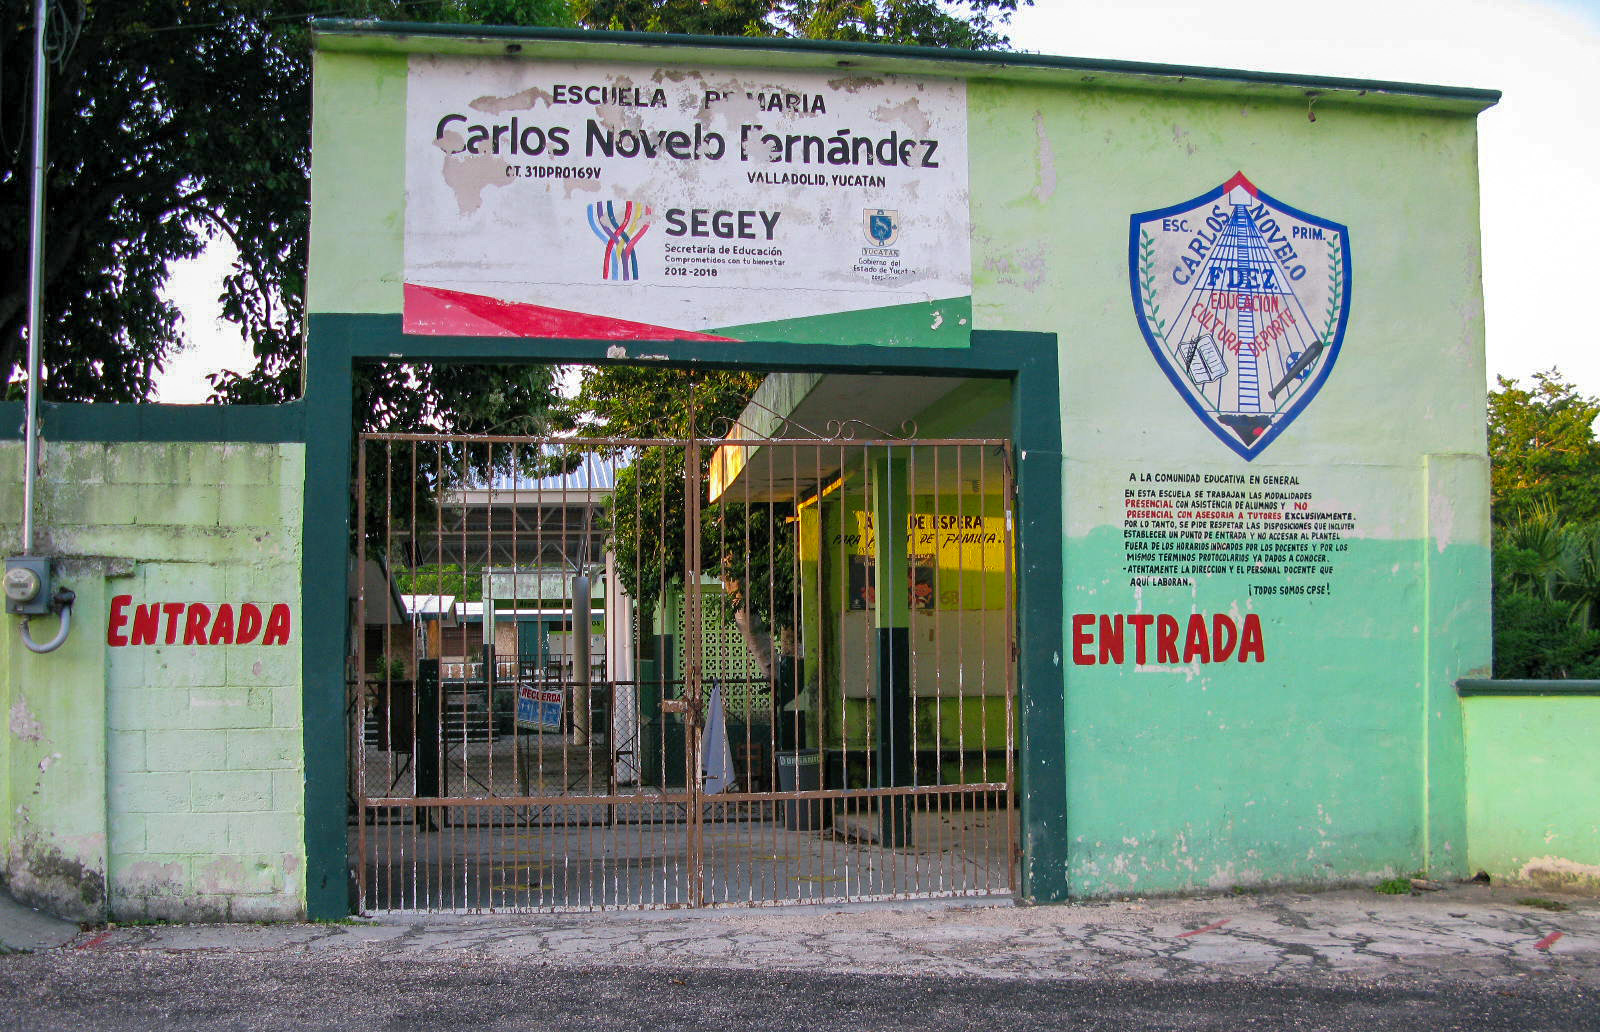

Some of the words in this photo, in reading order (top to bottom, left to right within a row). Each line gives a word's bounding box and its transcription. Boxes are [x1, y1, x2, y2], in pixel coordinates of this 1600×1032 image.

[553, 84, 668, 108] ESCUELA
[704, 90, 827, 114] PMARIA
[436, 113, 570, 157] Carlos
[585, 119, 726, 160] Novelo
[740, 124, 939, 168] Fernández
[747, 171, 829, 187] VALLADOLID,
[832, 174, 886, 188] YUCATAN
[665, 208, 781, 240] SEGEY
[1162, 218, 1193, 233] ESC.
[1292, 226, 1327, 241] PRIM.
[1172, 204, 1230, 286] CARLOS
[1250, 203, 1307, 281] NOVELO
[719, 245, 730, 254] de
[733, 246, 782, 256] Educación
[664, 255, 725, 264] Comprometidos
[858, 258, 886, 266] Gobierno
[853, 264, 878, 272] Estado
[889, 267, 916, 275] Yucatn
[1211, 293, 1279, 313] EDUCACION
[1191, 303, 1243, 356] CULTURA
[1248, 308, 1297, 358] DEPORTE
[1129, 472, 1136, 482] A
[1140, 473, 1152, 482] LA
[1154, 474, 1200, 483] COMUNIDAD
[1204, 474, 1246, 484] EDUCATIVA
[1249, 475, 1260, 484] EN
[1262, 476, 1300, 486] GENERAL
[1124, 490, 1134, 498] EN
[1138, 490, 1156, 498] ESTA
[1160, 490, 1192, 498] ESCUELA
[1194, 490, 1204, 498] SE
[1206, 490, 1246, 499] TRABAJAN
[1249, 492, 1262, 500] LAS
[1264, 492, 1312, 500] MODALIDADES
[1125, 499, 1174, 508] PRESENCIAL
[1175, 500, 1188, 509] CON
[1191, 500, 1232, 509] ASISTENCIA
[1235, 501, 1244, 509] DE
[1245, 502, 1278, 510] ALUMNOS
[1280, 502, 1286, 510] Y
[1294, 502, 1308, 510] NO
[1126, 510, 1174, 519] PRESENCIAL
[1177, 510, 1192, 519] CON
[1196, 511, 1234, 520] ASESORIA
[1248, 512, 1282, 520] TUTORES
[1284, 512, 1356, 520] EXCLUSIVAMENTE.
[933, 515, 983, 530] ESPERA
[1124, 520, 1138, 528] POR
[1140, 520, 1150, 528] LO
[1152, 520, 1177, 529] TANTO,
[1191, 521, 1207, 529] PIDE
[1210, 521, 1244, 529] RESPETAR
[1264, 522, 1312, 530] DISPOSICIONES
[1314, 522, 1326, 530] QUE
[1124, 530, 1166, 538] ESTABLECER
[1168, 530, 1178, 539] UN
[1180, 530, 1202, 539] PUNTO
[1204, 531, 1212, 540] DE
[1215, 531, 1247, 540] ENTRADA
[1250, 532, 1256, 540] Y
[1257, 532, 1267, 540] NO
[1269, 532, 1298, 540] ACCESAR
[1125, 542, 1148, 550] FUERA
[1151, 542, 1160, 550] DE
[1162, 542, 1174, 550] LOS
[1176, 542, 1209, 550] HORARIOS
[1210, 542, 1243, 551] INDICADOS
[1245, 543, 1258, 551] POR
[1260, 543, 1273, 551] LOS
[1275, 543, 1308, 552] DOCENTES
[1312, 544, 1317, 552] Y
[1320, 544, 1333, 552] POR
[1336, 544, 1348, 552] LOS
[1126, 553, 1156, 561] MISMOS
[1158, 553, 1196, 562] TERMINOS
[1199, 553, 1249, 562] PROTOCOLARIOS
[1252, 554, 1262, 562] YA
[1264, 554, 1286, 562] DADOS
[1295, 554, 1330, 562] CONOCER.
[1181, 565, 1190, 574] LA
[1192, 566, 1227, 574] DIRECCION
[1228, 566, 1234, 574] Y
[1246, 566, 1281, 574] PERSONAL
[1284, 566, 1316, 574] DOCENTE
[1320, 566, 1334, 574] QUE
[1130, 576, 1150, 587] AQUÍ
[1152, 578, 1192, 587] LABORAN.
[1280, 585, 1305, 595] SOMOS
[1306, 582, 1331, 596] CPSE!
[107, 594, 292, 647] ENTRADA
[1072, 613, 1265, 666] ENTRADA
